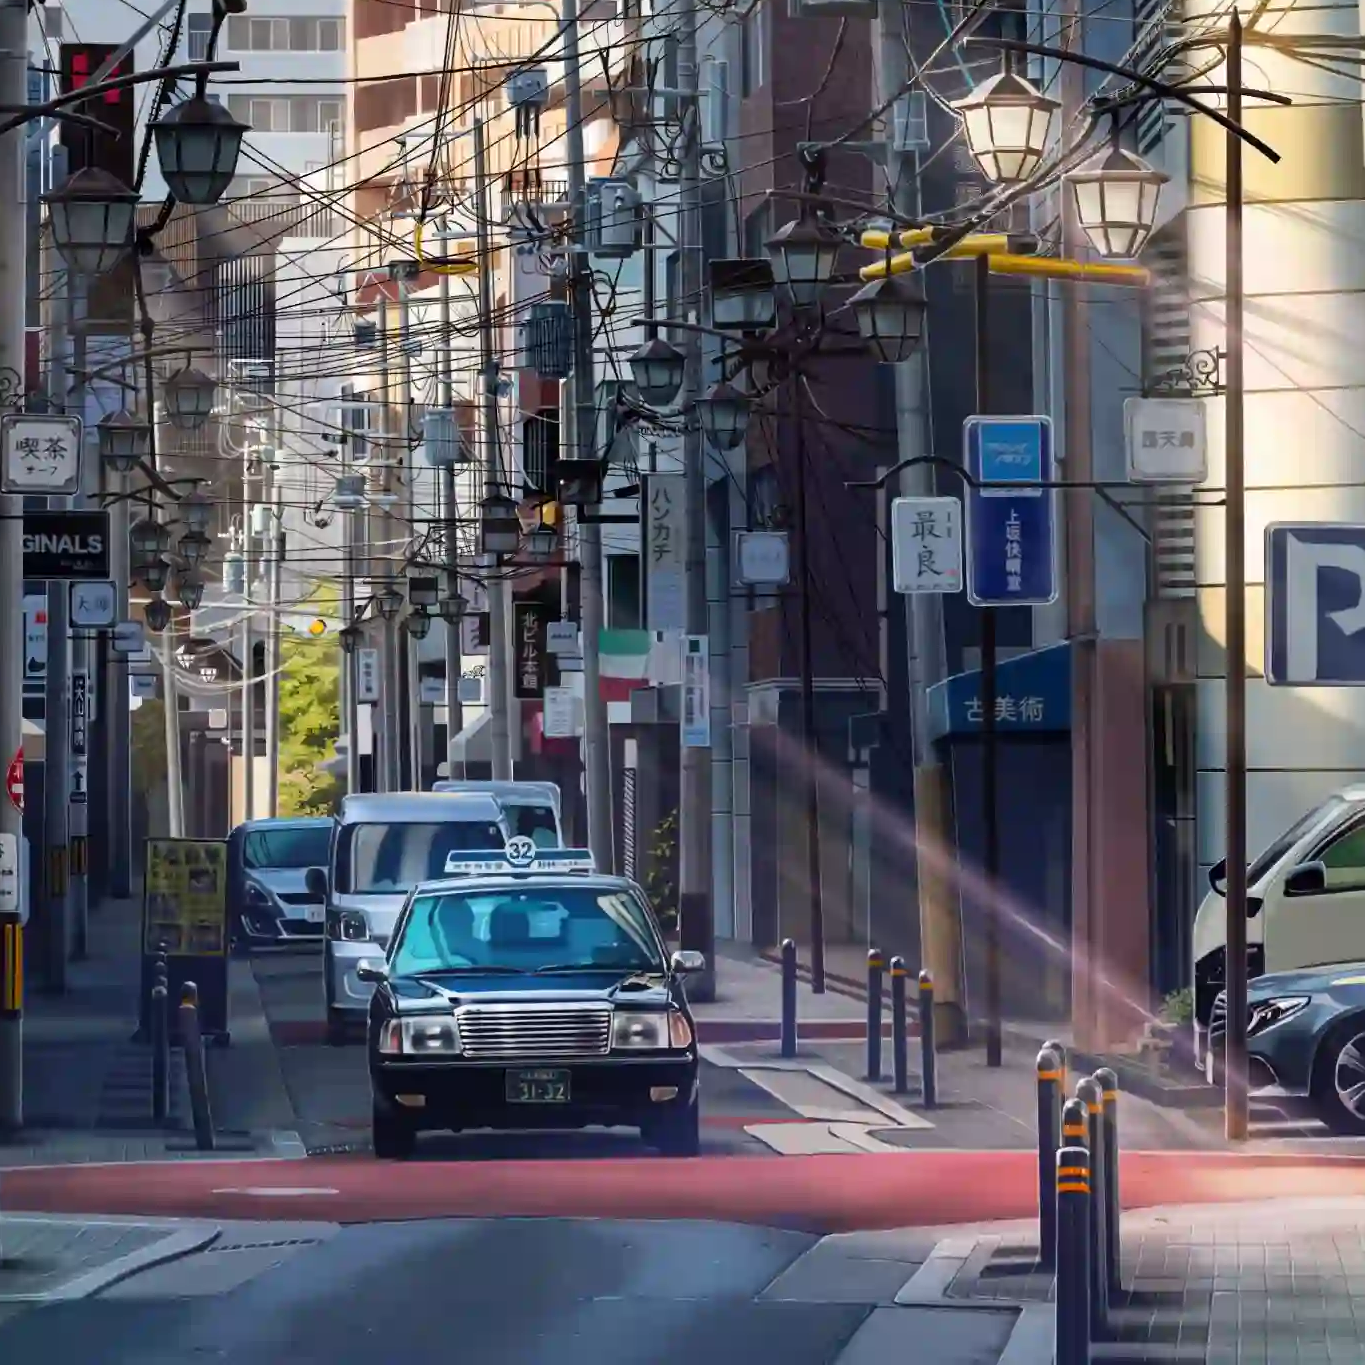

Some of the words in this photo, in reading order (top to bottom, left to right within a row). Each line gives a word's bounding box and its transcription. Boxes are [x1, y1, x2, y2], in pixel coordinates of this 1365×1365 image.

[16, 437, 67, 460] 喫茶
[651, 487, 672, 562] ハンカチ
[22, 534, 102, 554] GINALS
[910, 511, 944, 578] 最良
[963, 695, 1044, 722] 古美術
[509, 842, 533, 859] 32
